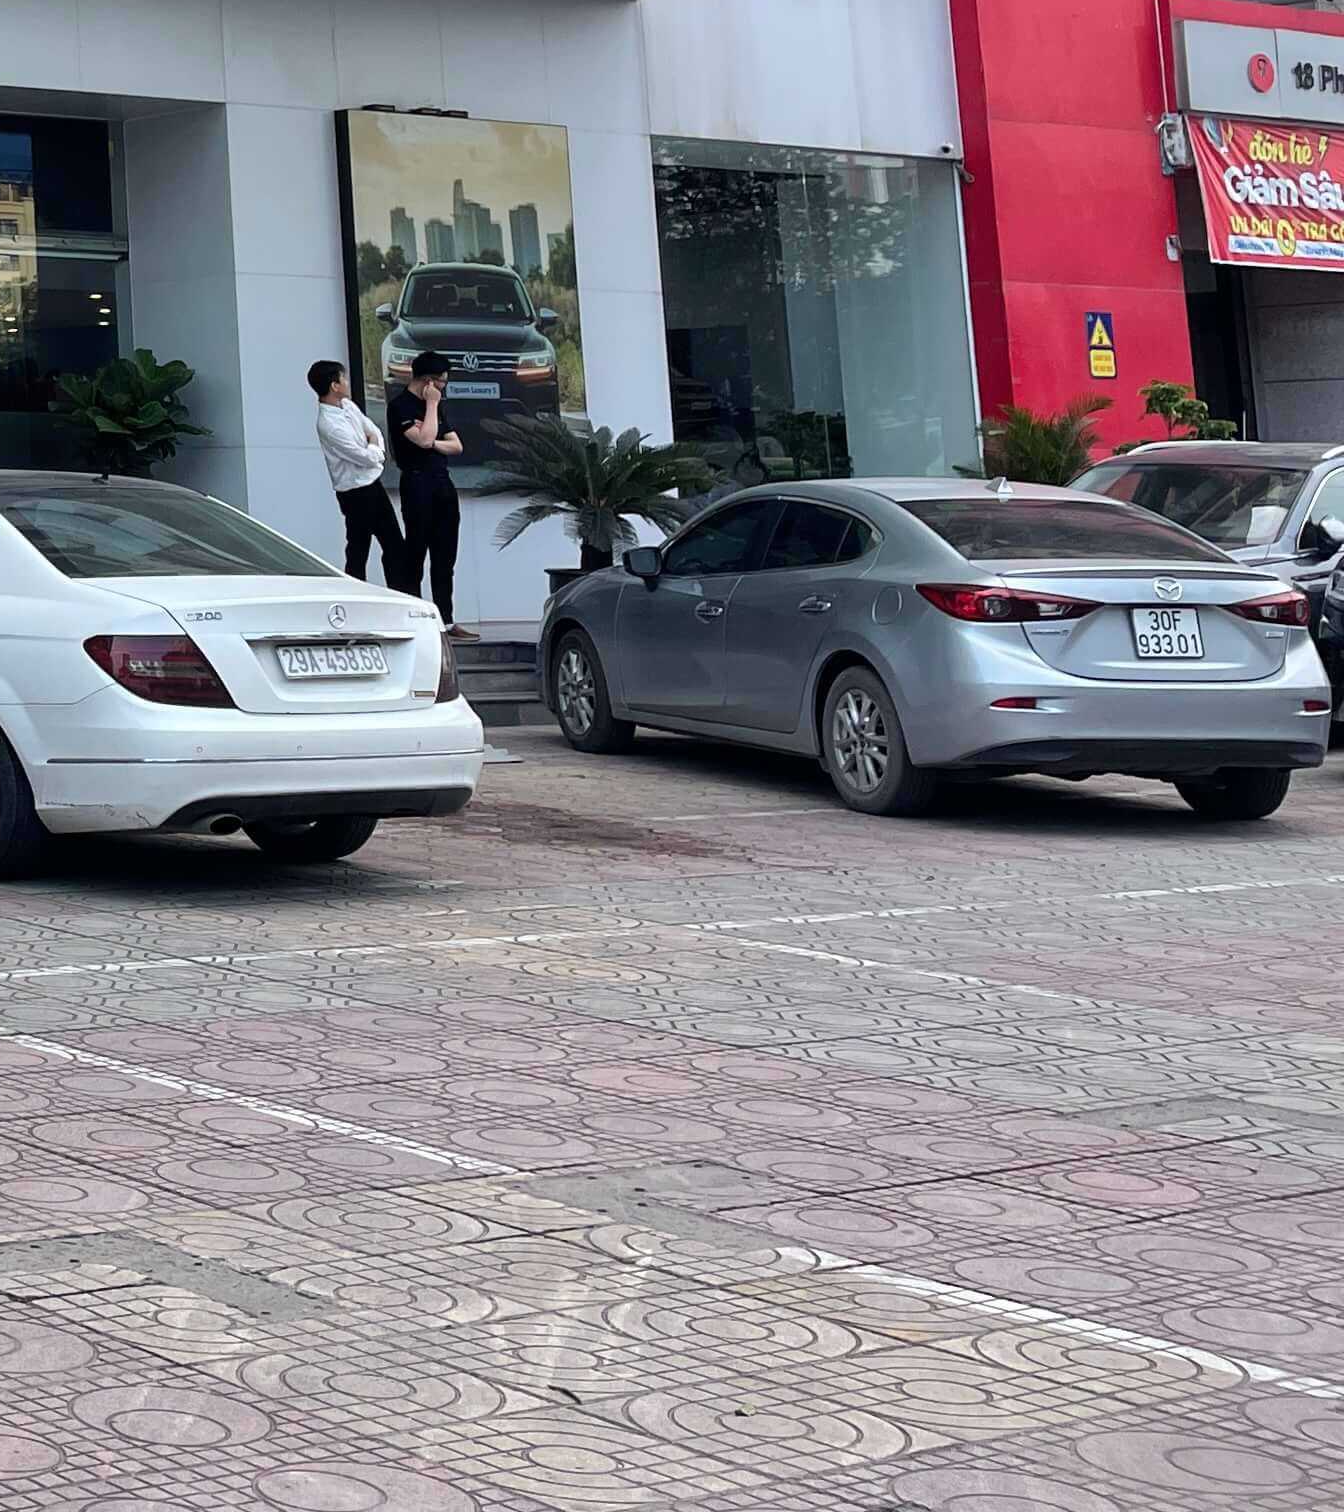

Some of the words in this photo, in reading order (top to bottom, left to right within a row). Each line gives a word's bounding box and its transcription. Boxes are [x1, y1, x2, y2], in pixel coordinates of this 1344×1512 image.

[1291, 61, 1314, 90] 18
[1224, 163, 1299, 207] Giảm
[1149, 610, 1182, 632] 30F
[1138, 634, 1200, 656] 933.01
